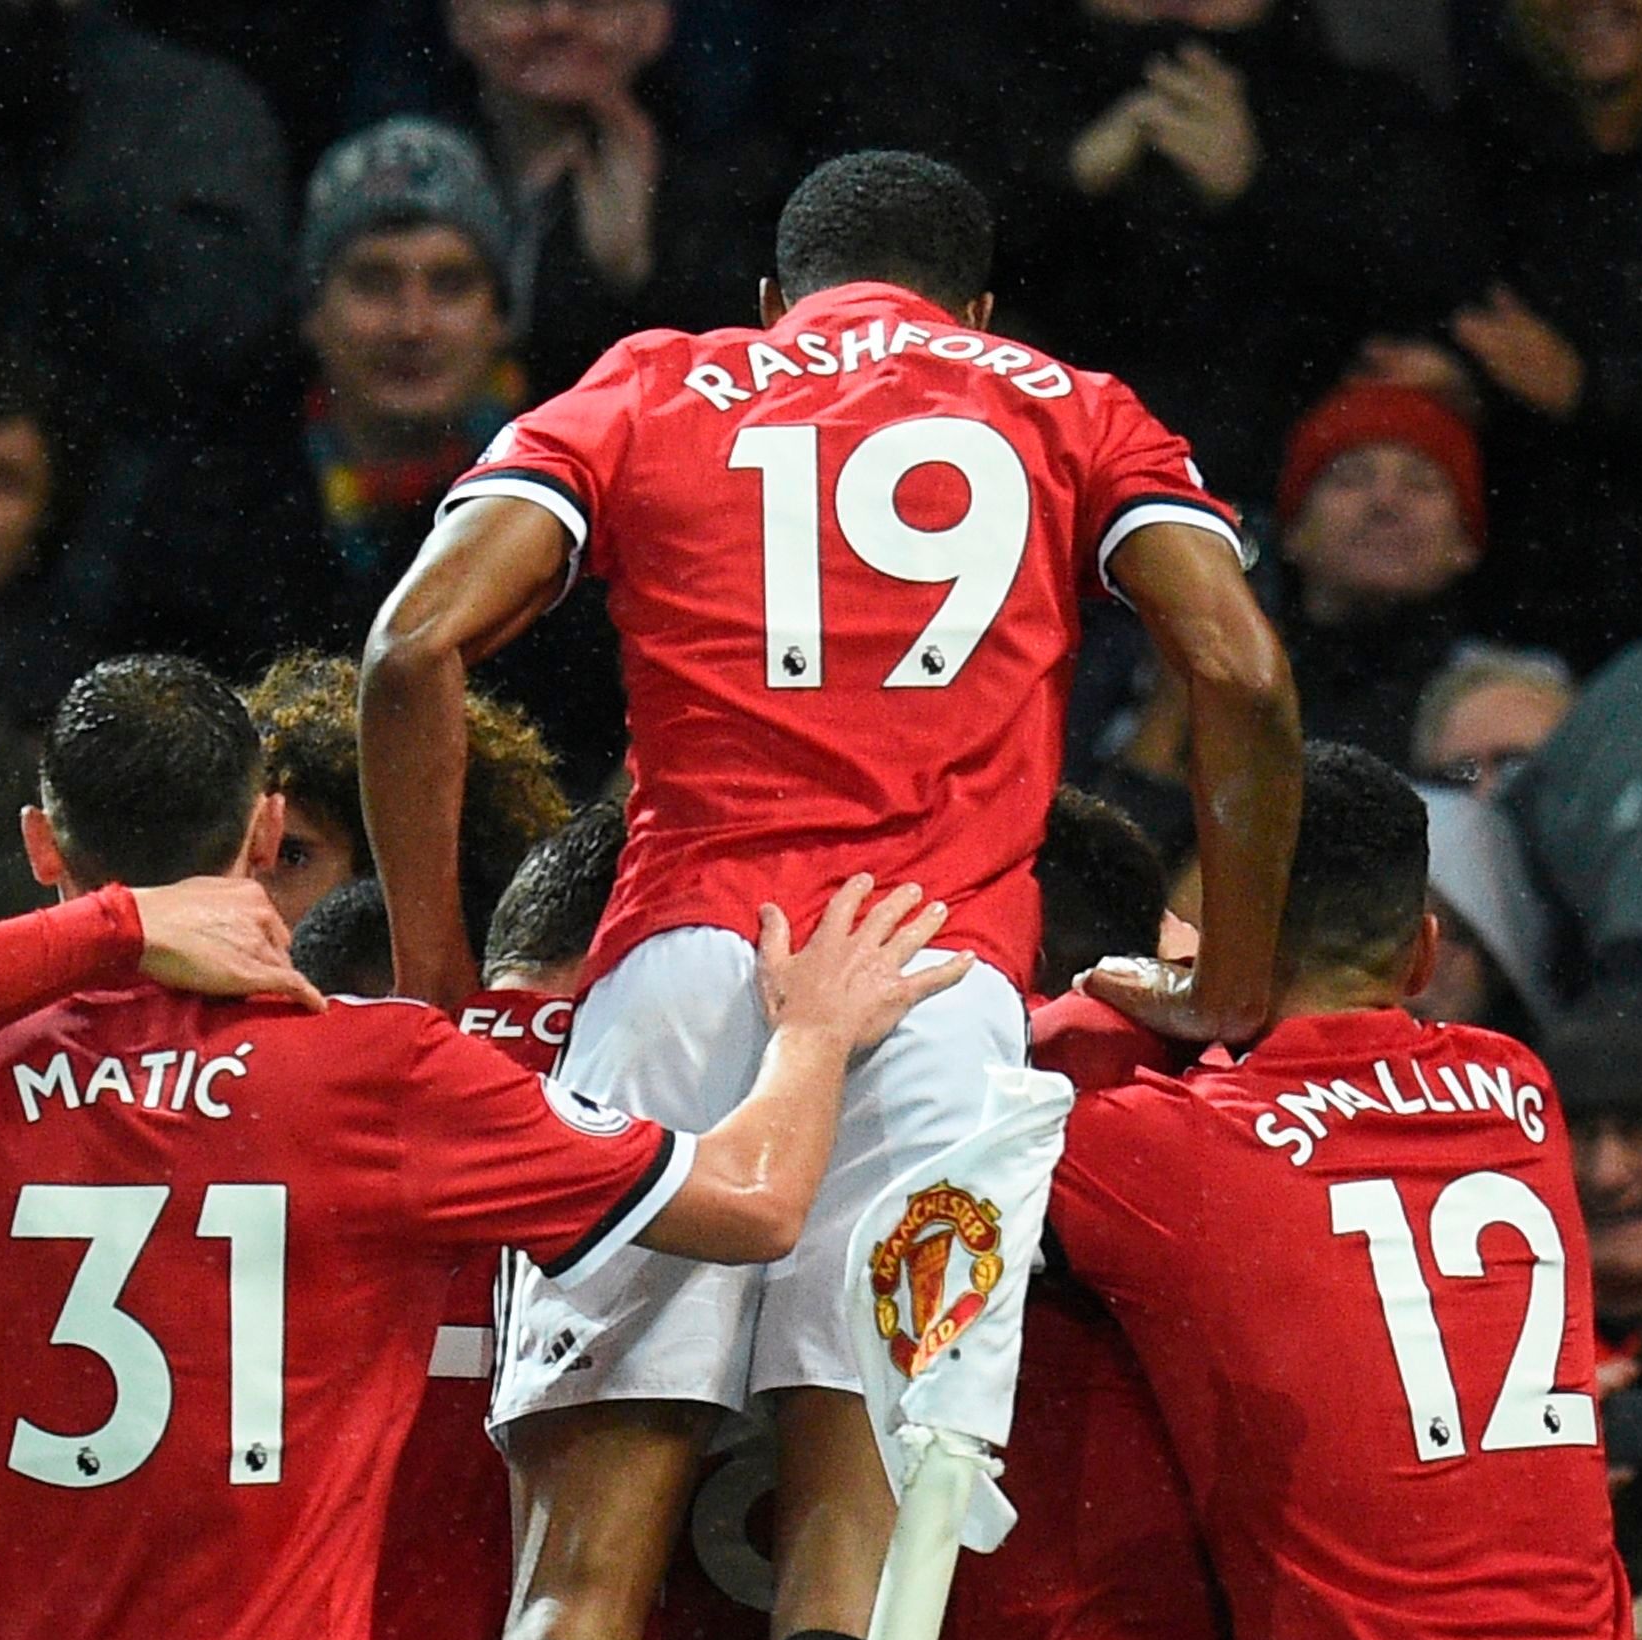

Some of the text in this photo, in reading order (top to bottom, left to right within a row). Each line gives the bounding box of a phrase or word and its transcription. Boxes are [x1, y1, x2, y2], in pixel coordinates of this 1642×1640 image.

[684, 320, 1073, 411] RASHFORD
[727, 416, 1030, 688] 19
[13, 1043, 253, 1122] MATIĆ
[1255, 1059, 1546, 1166] SMALLING
[7, 1183, 288, 1489] 31
[1329, 1170, 1598, 1461] 12
